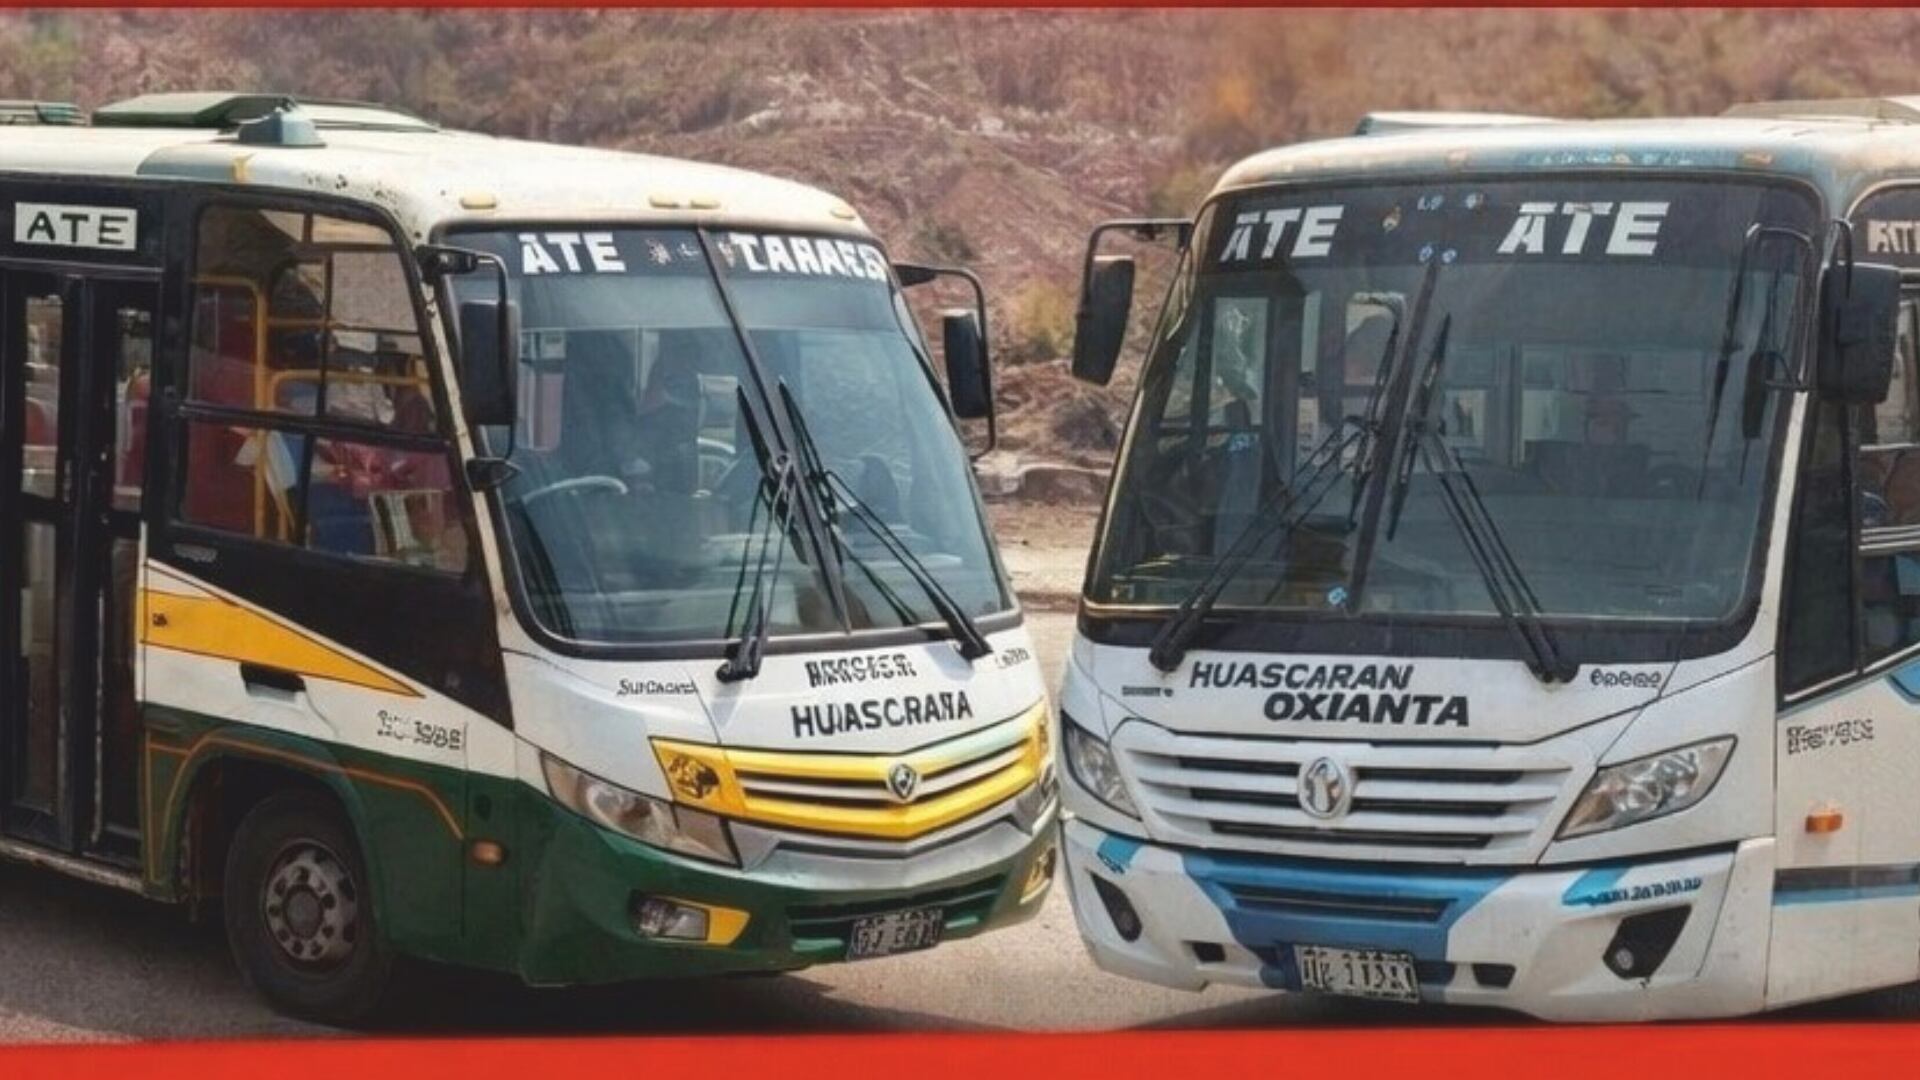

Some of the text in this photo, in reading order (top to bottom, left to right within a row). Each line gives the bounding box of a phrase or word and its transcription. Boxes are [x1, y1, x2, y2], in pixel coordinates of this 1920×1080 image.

[27, 211, 129, 245] ATE
[1219, 205, 1344, 262] ATE
[1496, 201, 1671, 255] ATE
[518, 232, 626, 274] ATE
[1190, 661, 1414, 690] HUASCARAN
[1264, 692, 1469, 727] OXIANTA
